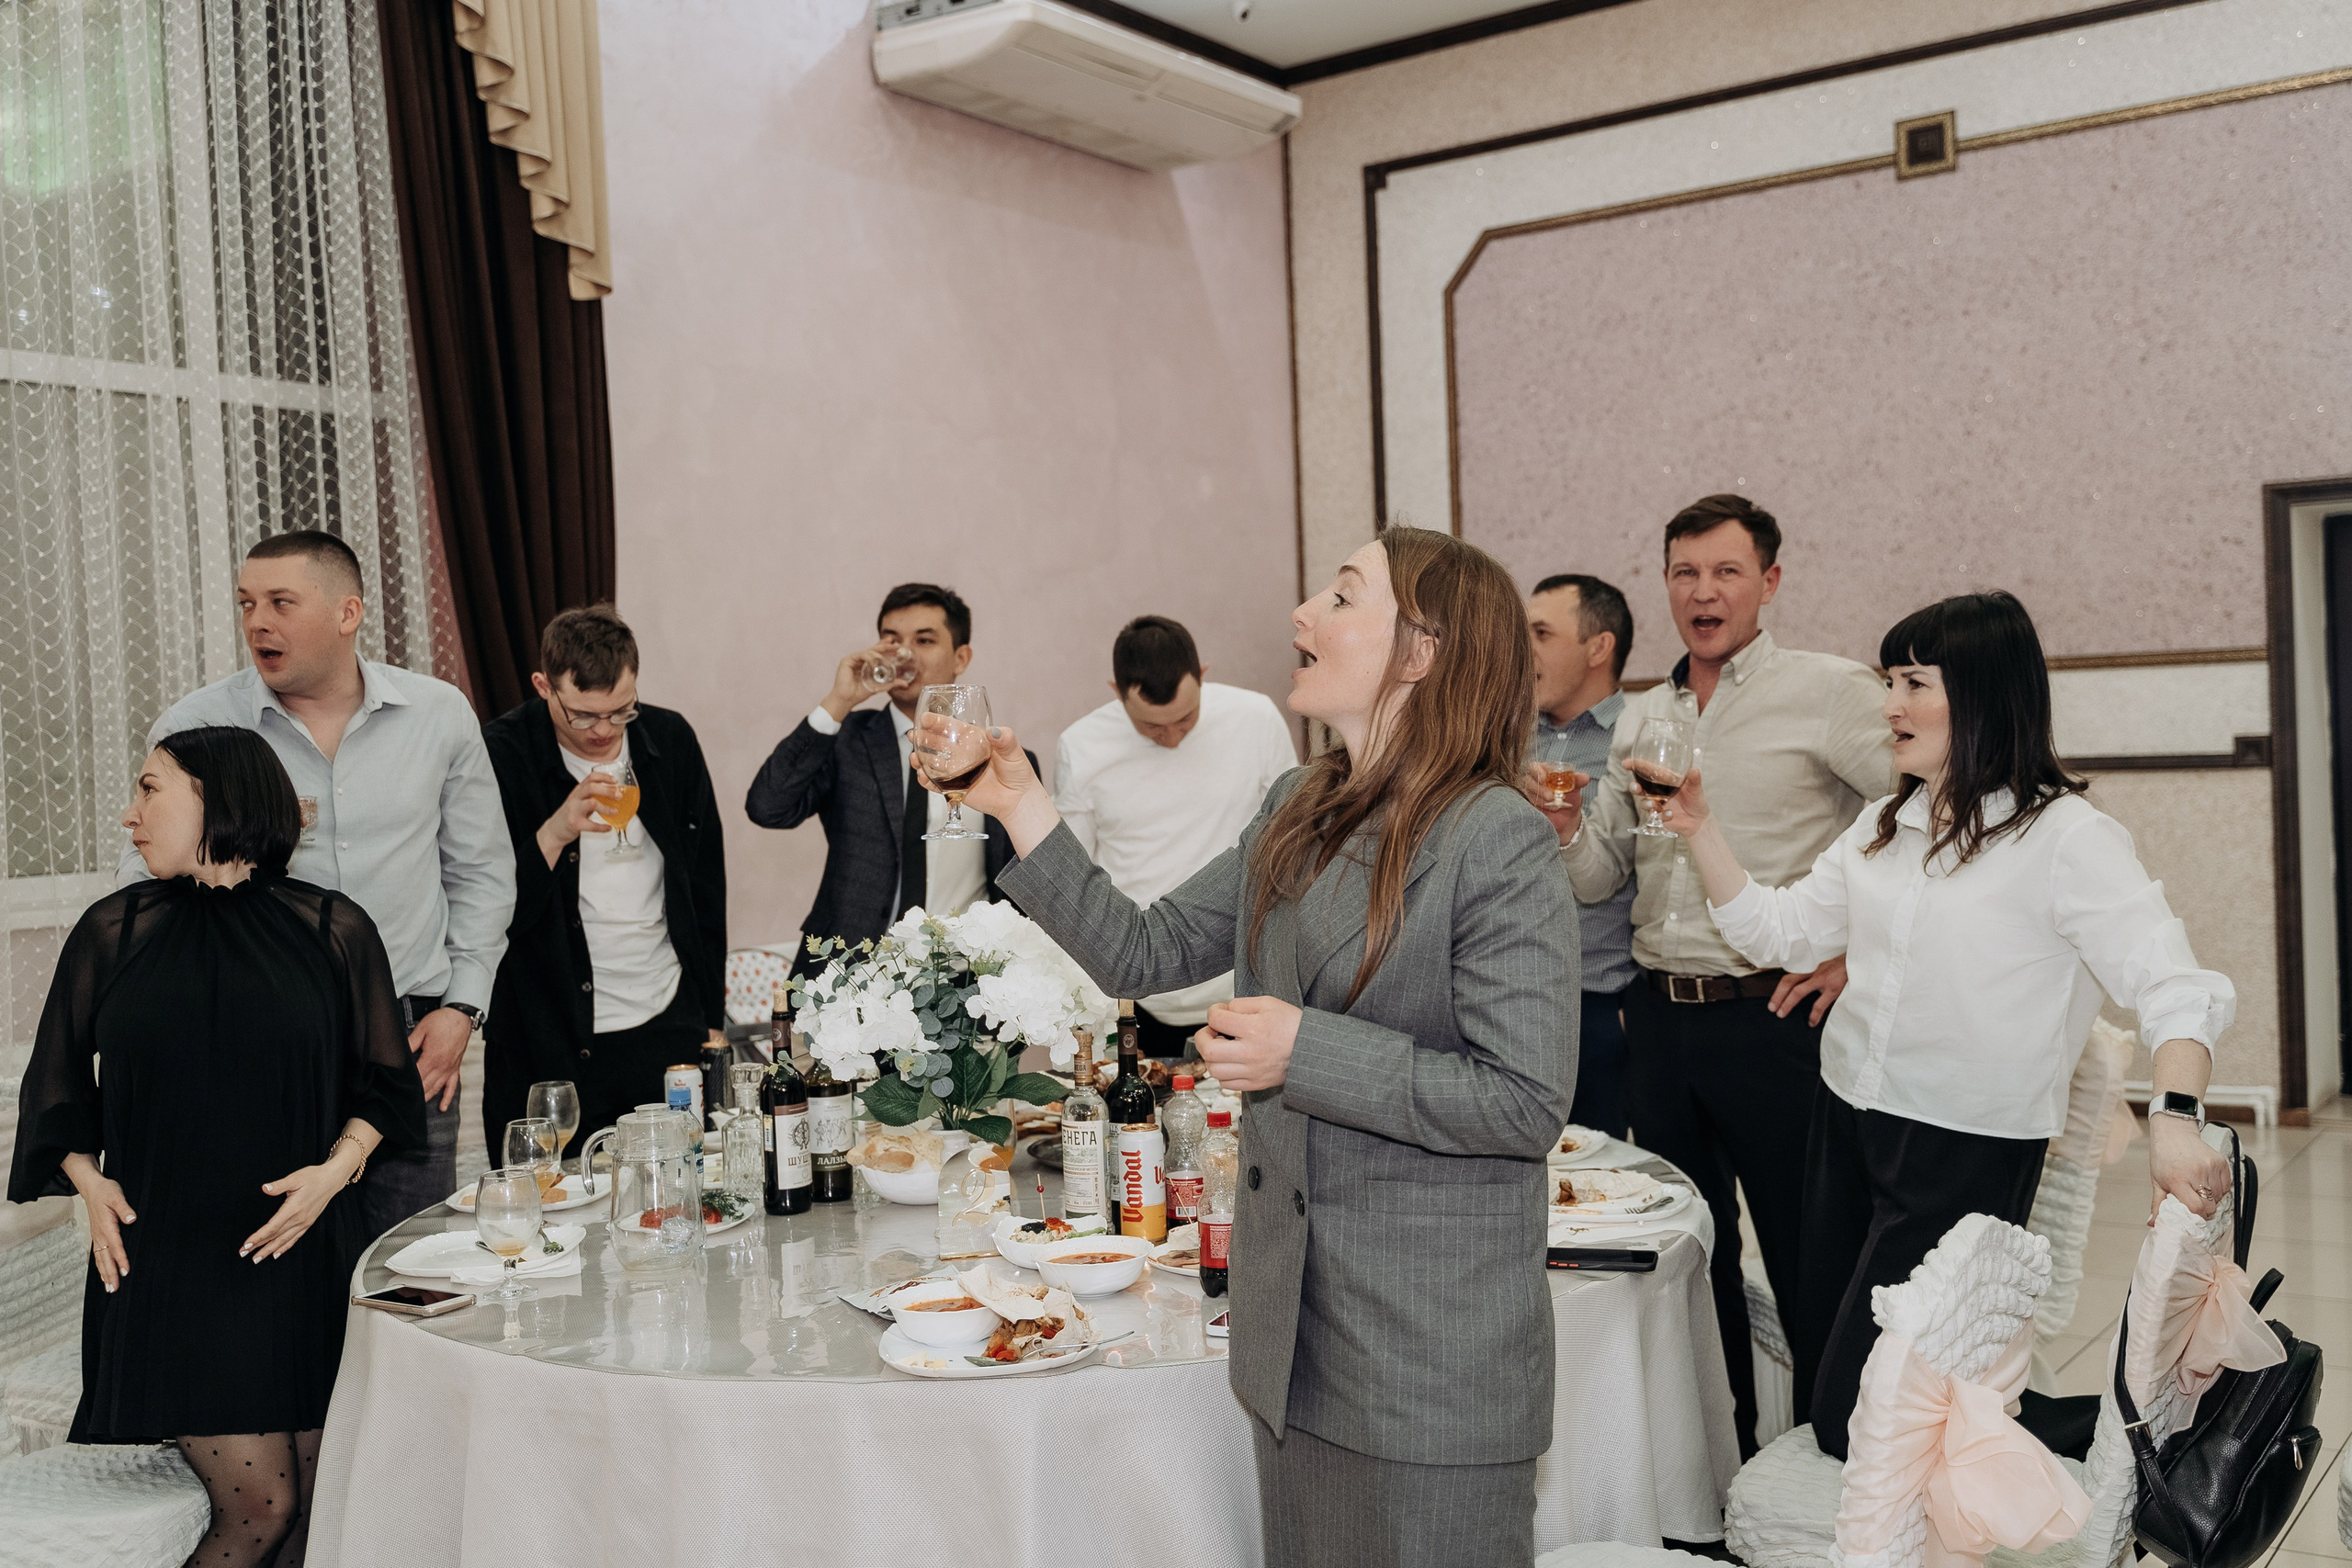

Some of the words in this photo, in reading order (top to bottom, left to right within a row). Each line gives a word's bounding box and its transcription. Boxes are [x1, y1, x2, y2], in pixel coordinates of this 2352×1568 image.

[787, 1153, 810, 1166] ШУШ
[1121, 1149, 1144, 1223] Vandal
[951, 1167, 995, 1228] 2
